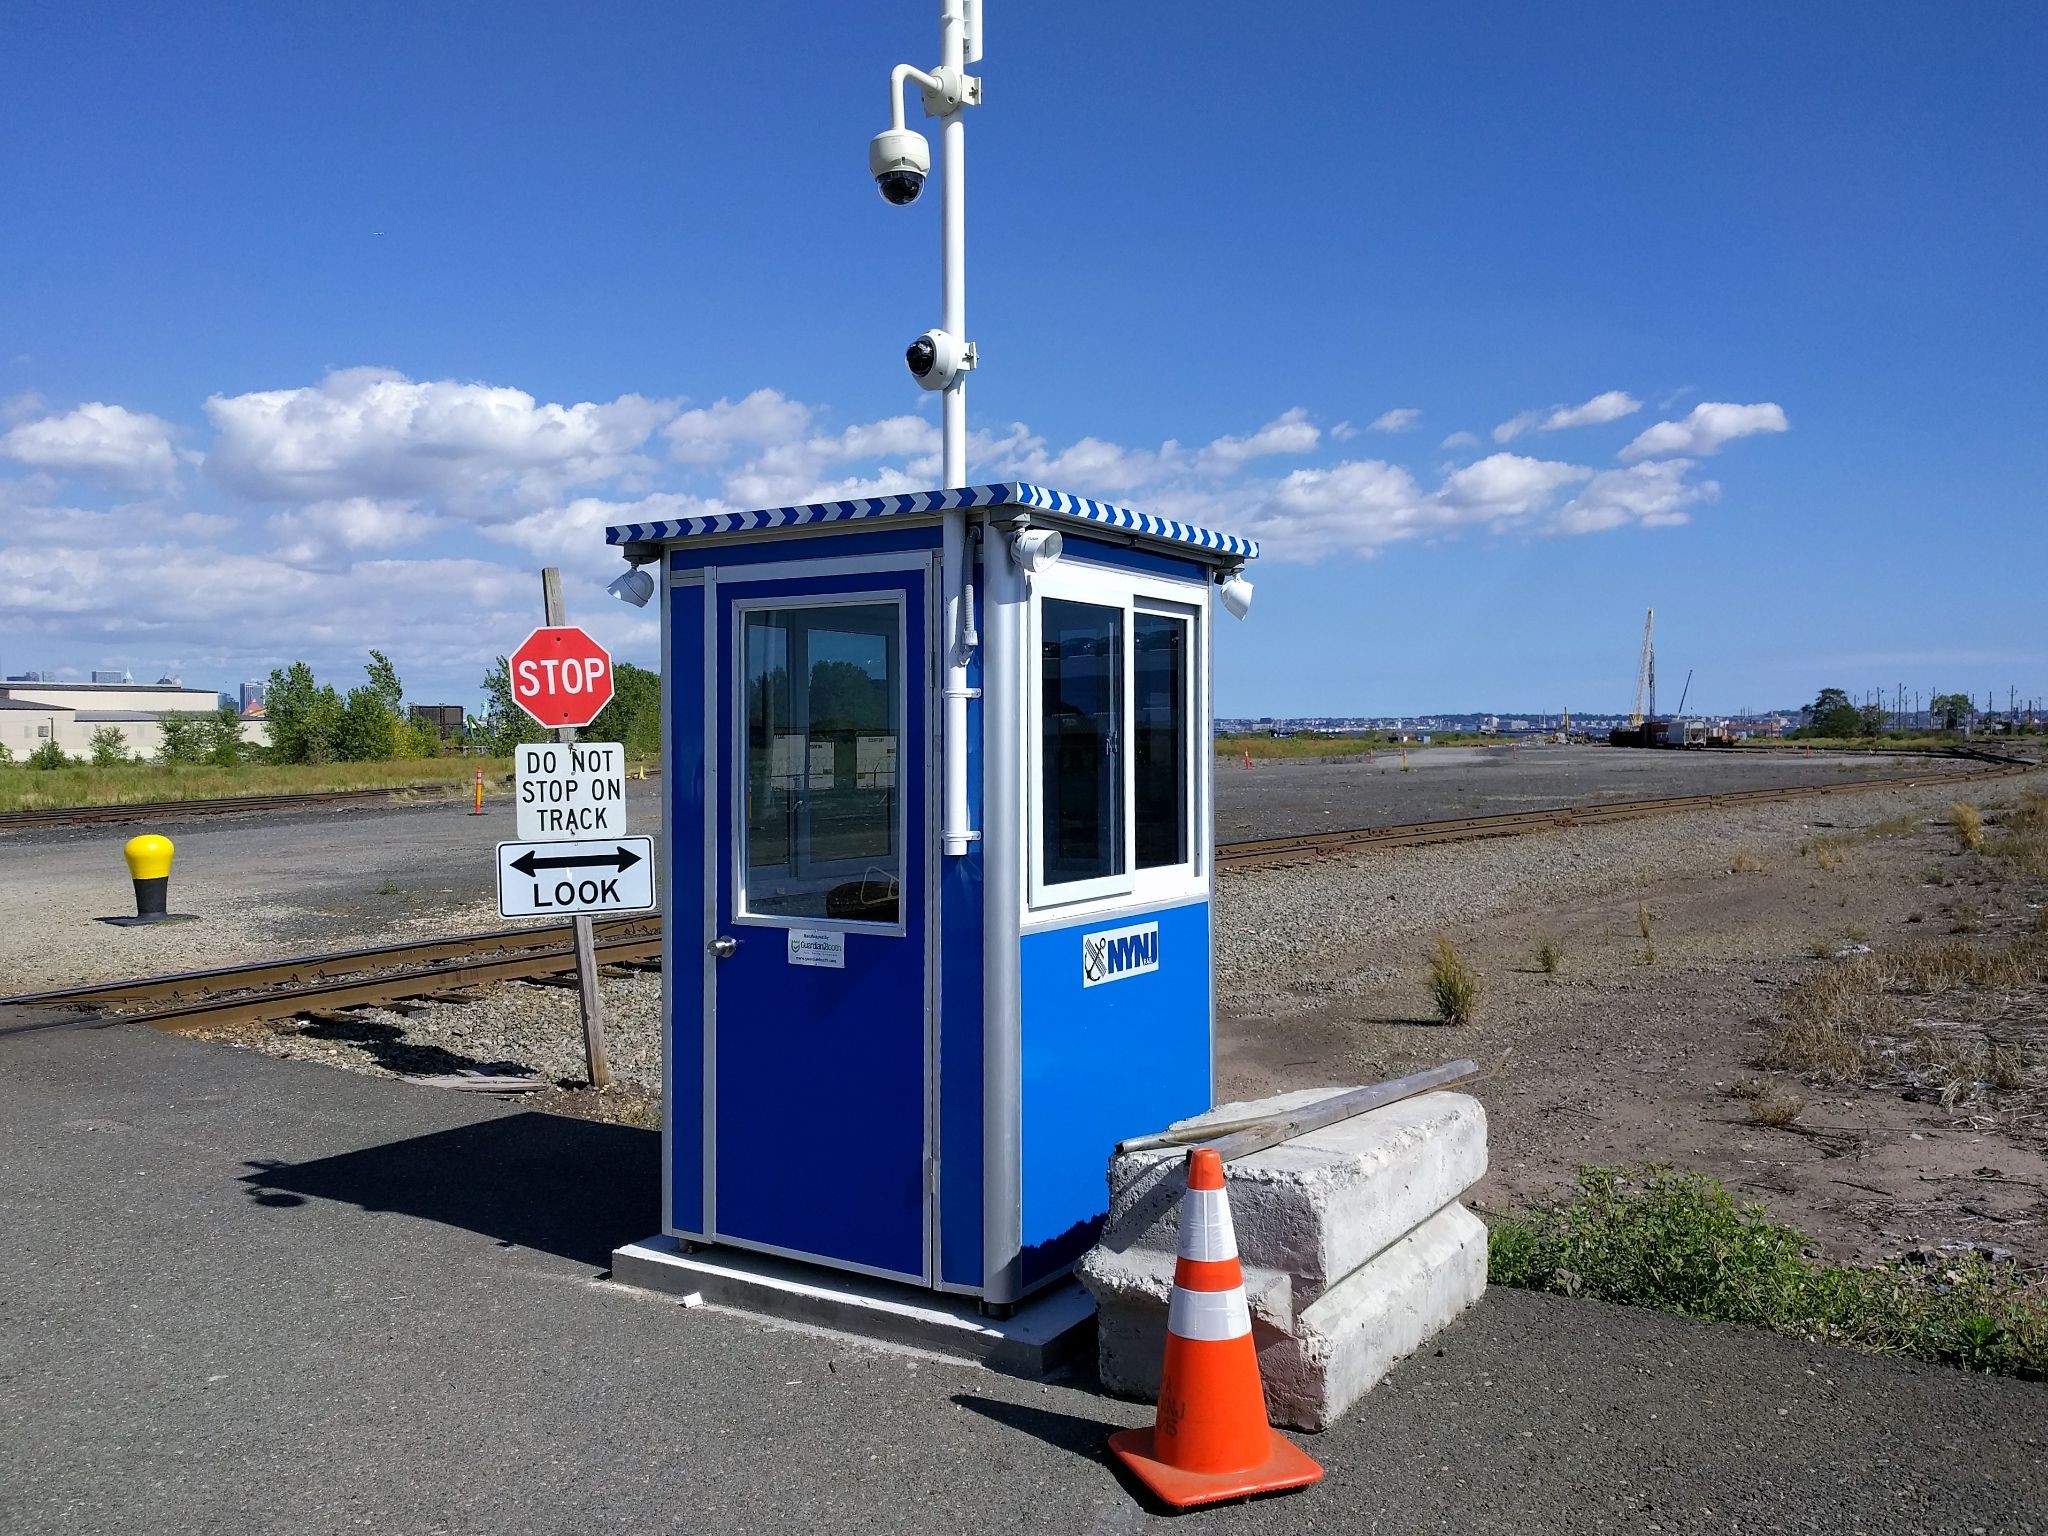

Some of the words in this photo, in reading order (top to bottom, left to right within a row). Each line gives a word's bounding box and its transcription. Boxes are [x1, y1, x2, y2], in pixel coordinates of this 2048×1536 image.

[518, 657, 605, 697] STOP
[527, 751, 557, 774] DO
[571, 750, 613, 773] NOT
[522, 780, 578, 803] STOP
[591, 779, 621, 801] ON
[537, 807, 608, 831] TRACK
[533, 878, 621, 907] LOOK
[1107, 931, 1158, 974] NYNJ
